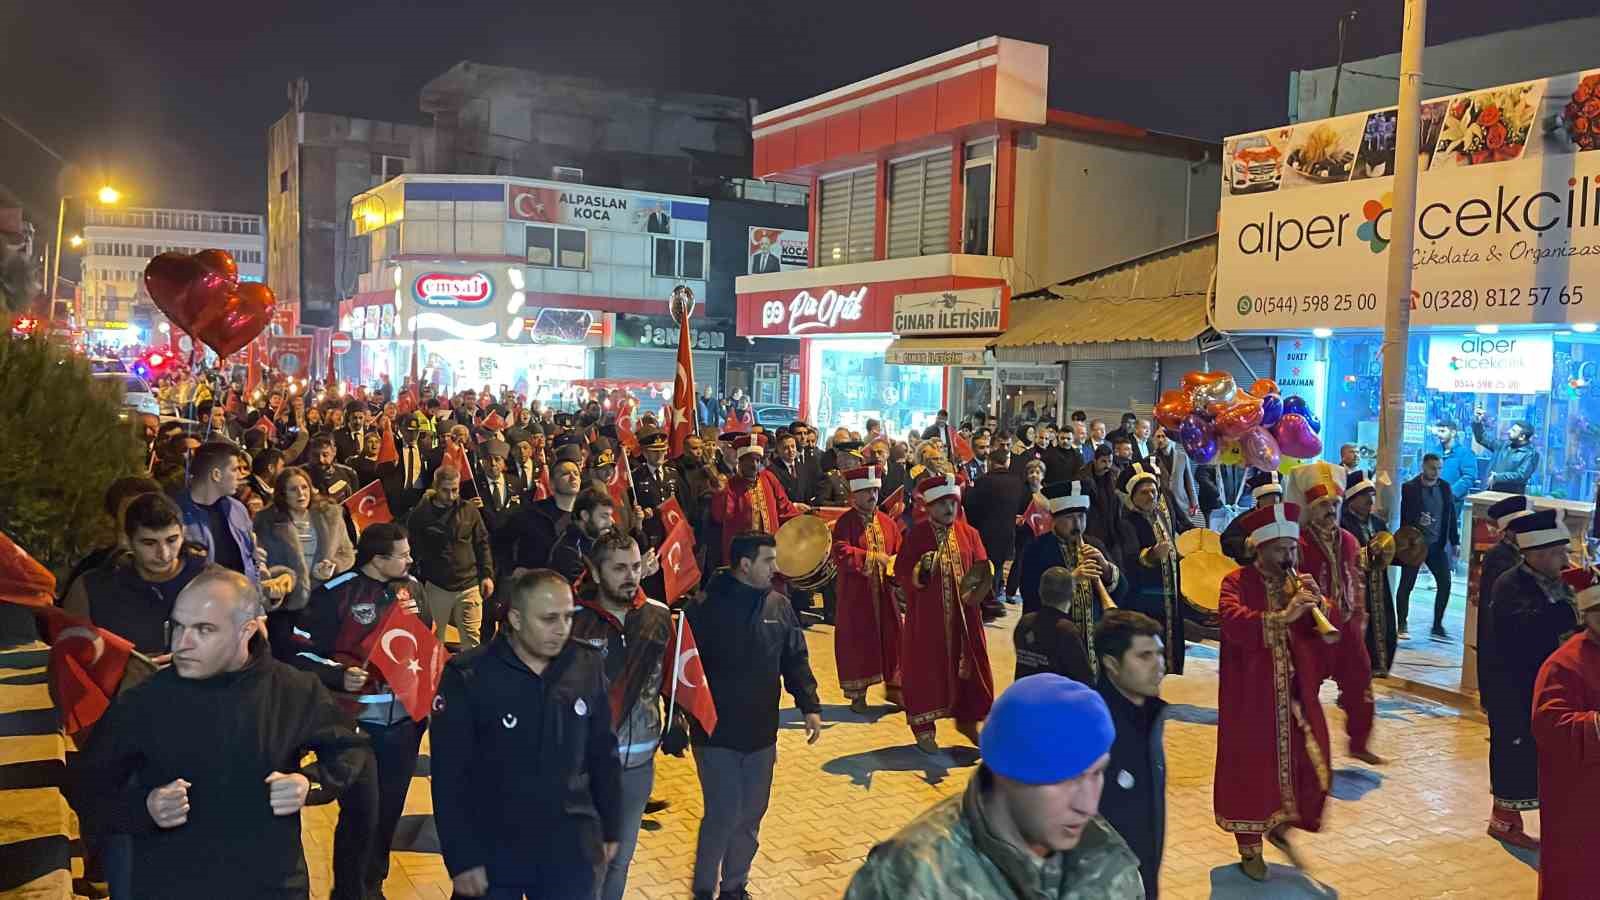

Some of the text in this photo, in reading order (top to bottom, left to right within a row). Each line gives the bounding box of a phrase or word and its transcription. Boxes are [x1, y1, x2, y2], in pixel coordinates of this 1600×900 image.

[559, 192, 627, 210] ALPASLAN
[574, 207, 611, 221] KOCA
[1238, 211, 1350, 261] alper
[1254, 292, 1377, 315] 0(544) 598 25 00
[1423, 285, 1584, 312] 0(328) 812 57 65
[939, 307, 999, 331] İLETİŞİM
[1461, 335, 1517, 357] alper
